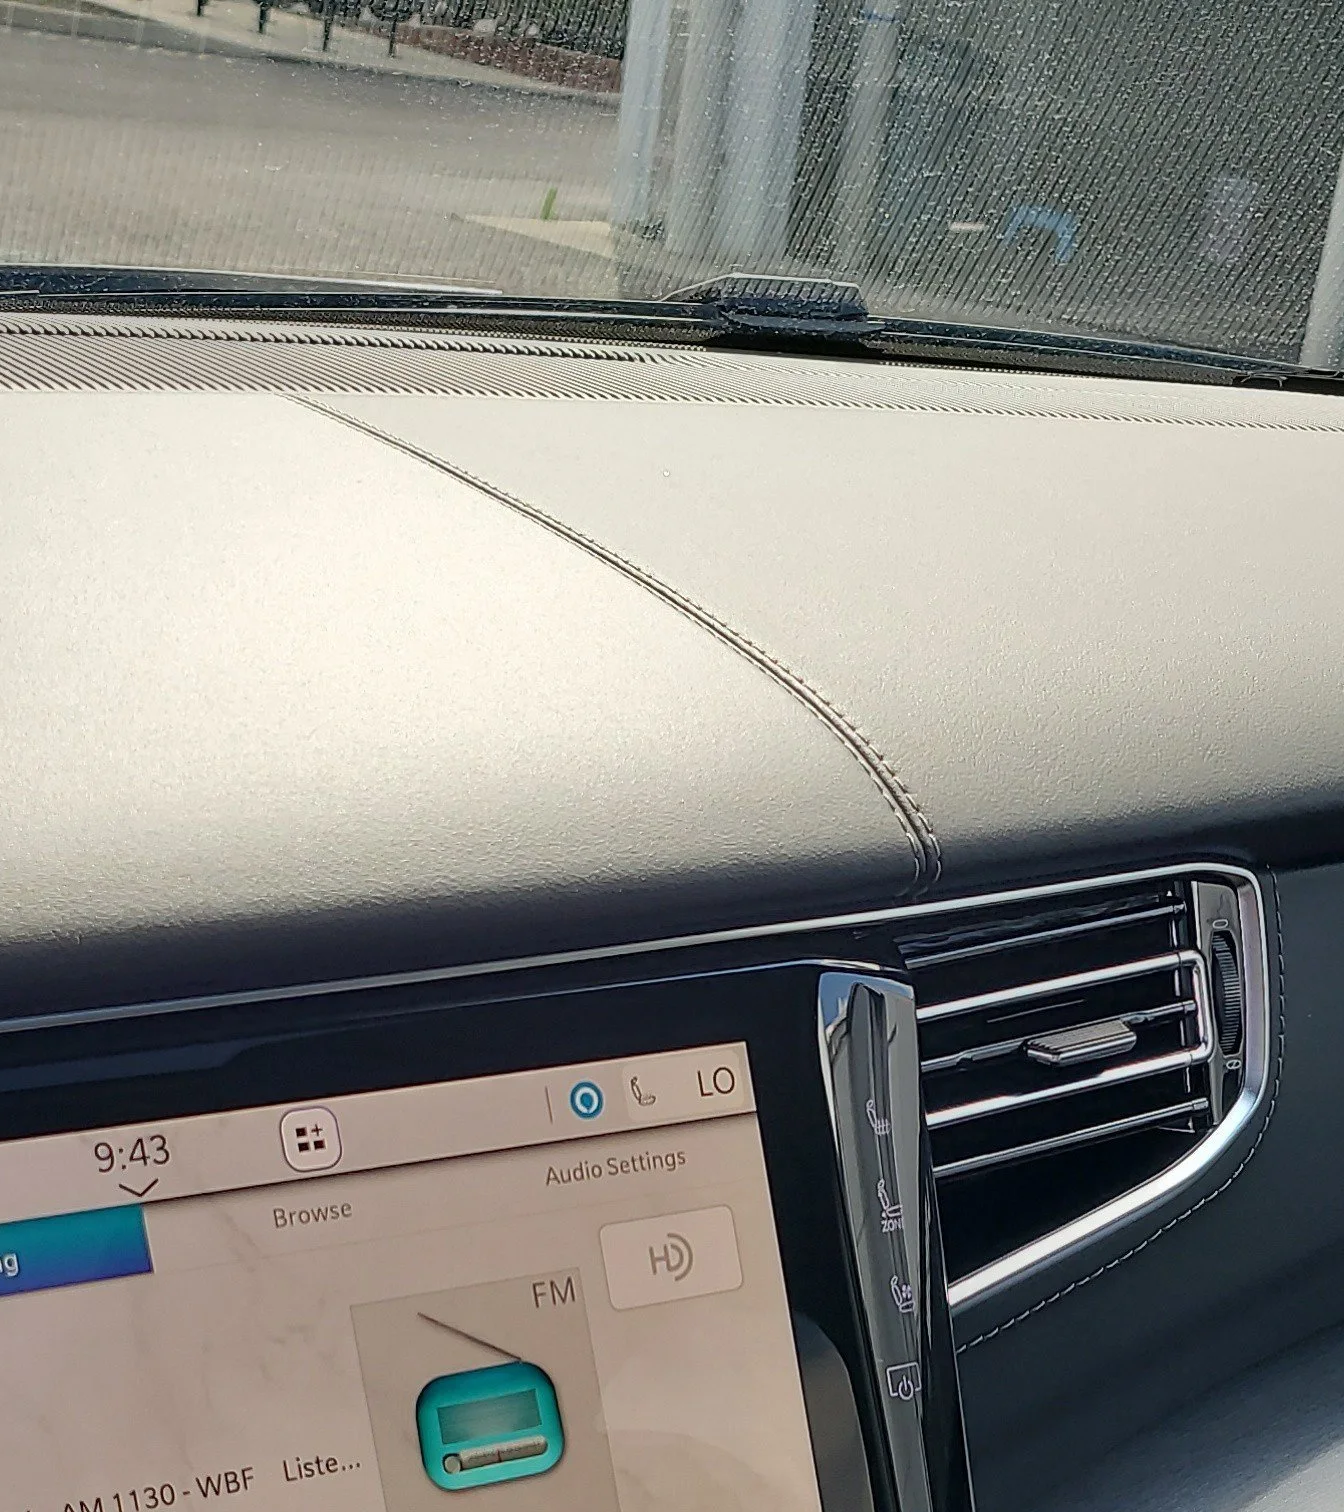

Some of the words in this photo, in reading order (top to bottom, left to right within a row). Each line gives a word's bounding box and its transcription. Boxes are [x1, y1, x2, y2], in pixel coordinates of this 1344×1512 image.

[697, 1067, 737, 1099] LO
[93, 1134, 172, 1174] 9:43
[545, 1162, 602, 1188] Audio
[606, 1147, 688, 1180] Settings
[272, 1200, 353, 1230] Browse
[881, 1217, 904, 1233] ZON
[532, 1276, 577, 1309] FM
[196, 1467, 257, 1502] WBF
